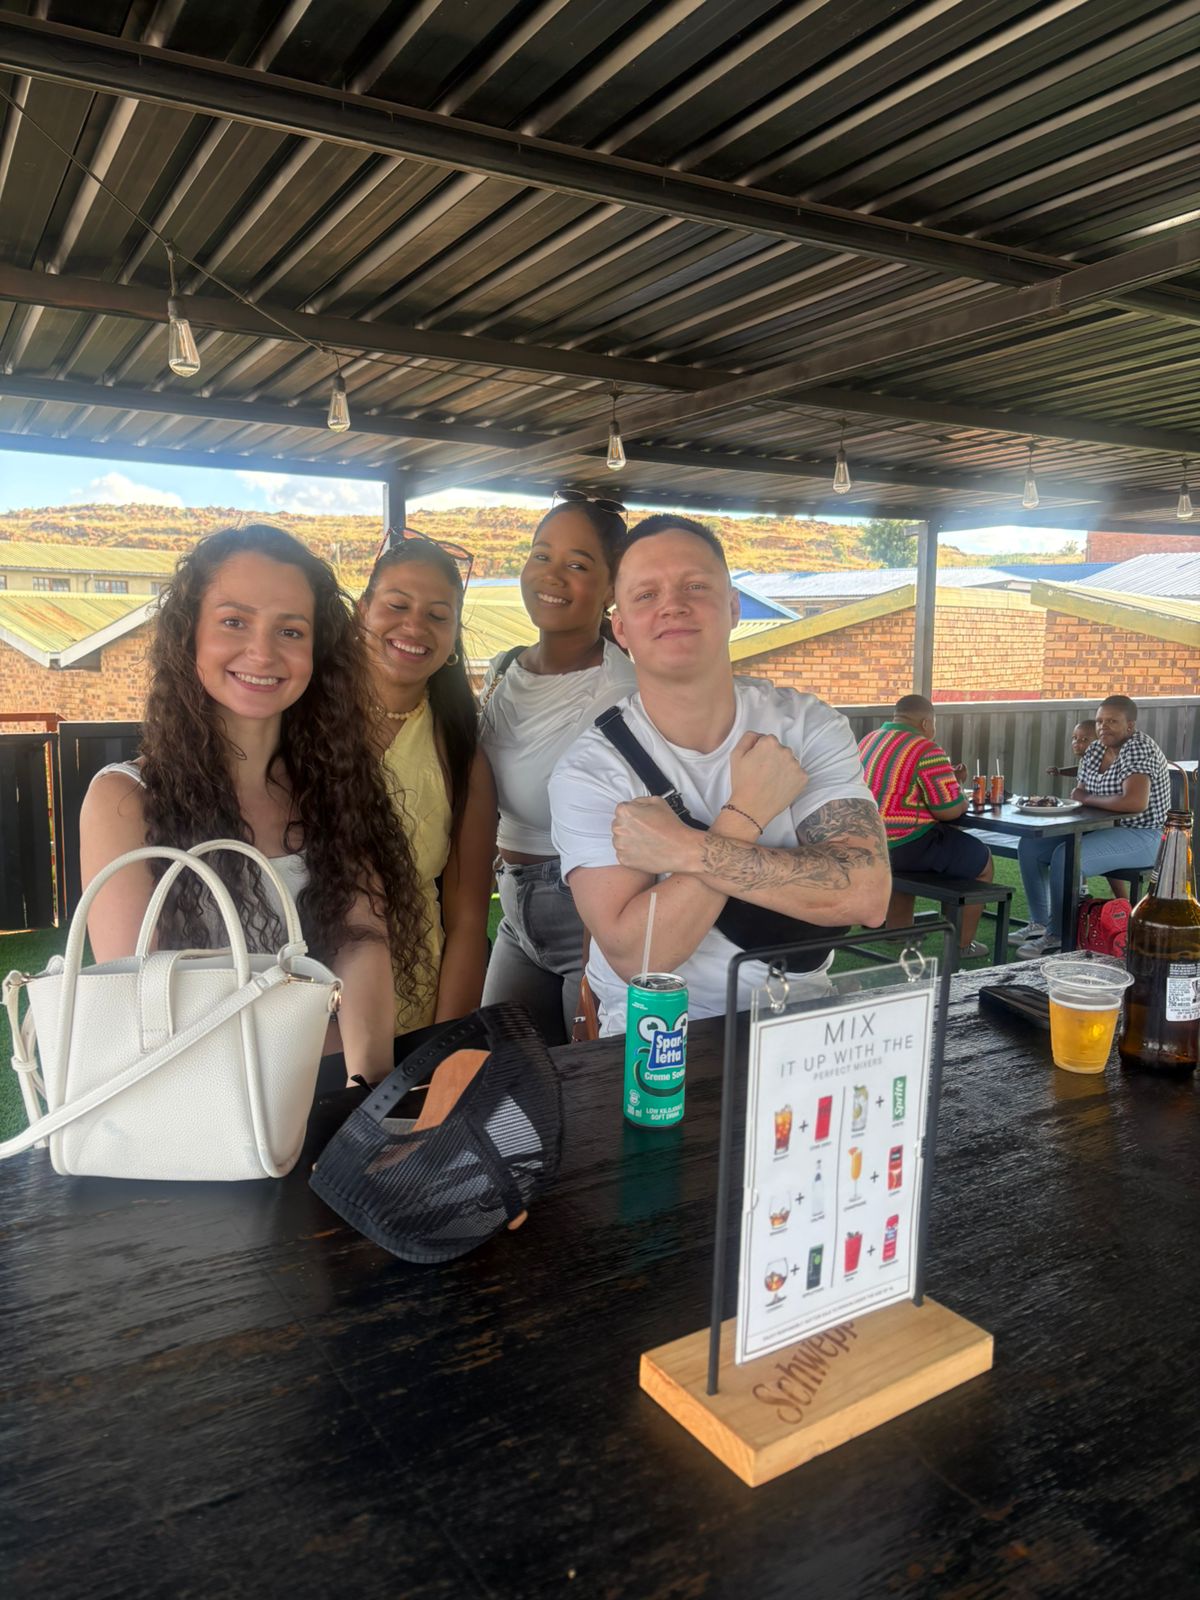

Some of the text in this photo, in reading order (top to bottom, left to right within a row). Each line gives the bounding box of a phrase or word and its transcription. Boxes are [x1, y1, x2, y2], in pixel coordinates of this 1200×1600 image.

[823, 1012, 876, 1046] MIX
[656, 1034, 683, 1052] Spar-
[655, 1049, 682, 1064] letta
[780, 1035, 914, 1078] IT UP WITH THE
[644, 1069, 685, 1081] Creme So
[813, 1065, 851, 1081] PERFECT
[894, 1079, 904, 1117] Sprite
